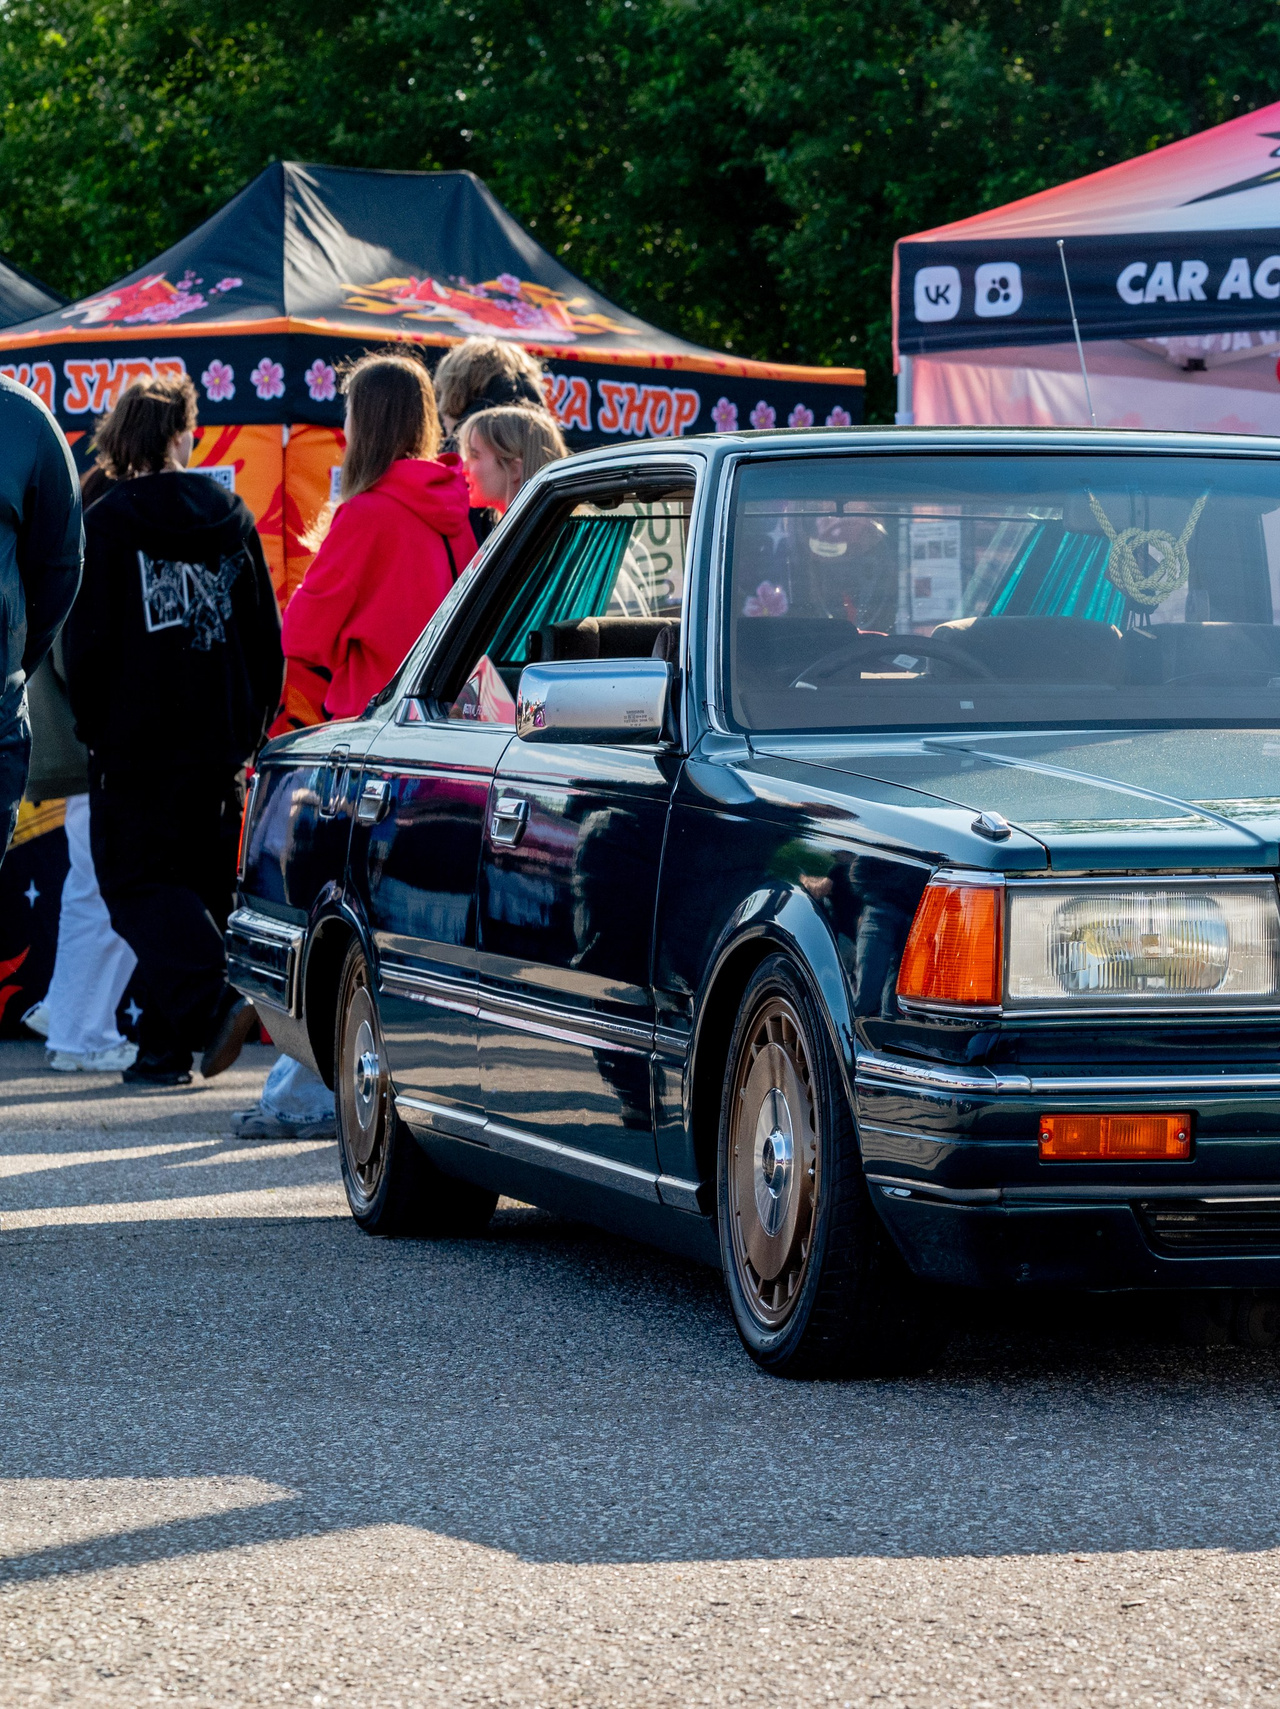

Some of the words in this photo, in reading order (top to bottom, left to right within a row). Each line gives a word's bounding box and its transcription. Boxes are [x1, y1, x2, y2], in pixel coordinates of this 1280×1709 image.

[925, 284, 951, 305] VK
[1116, 260, 1210, 304] CAR
[598, 379, 700, 437] SHOP
